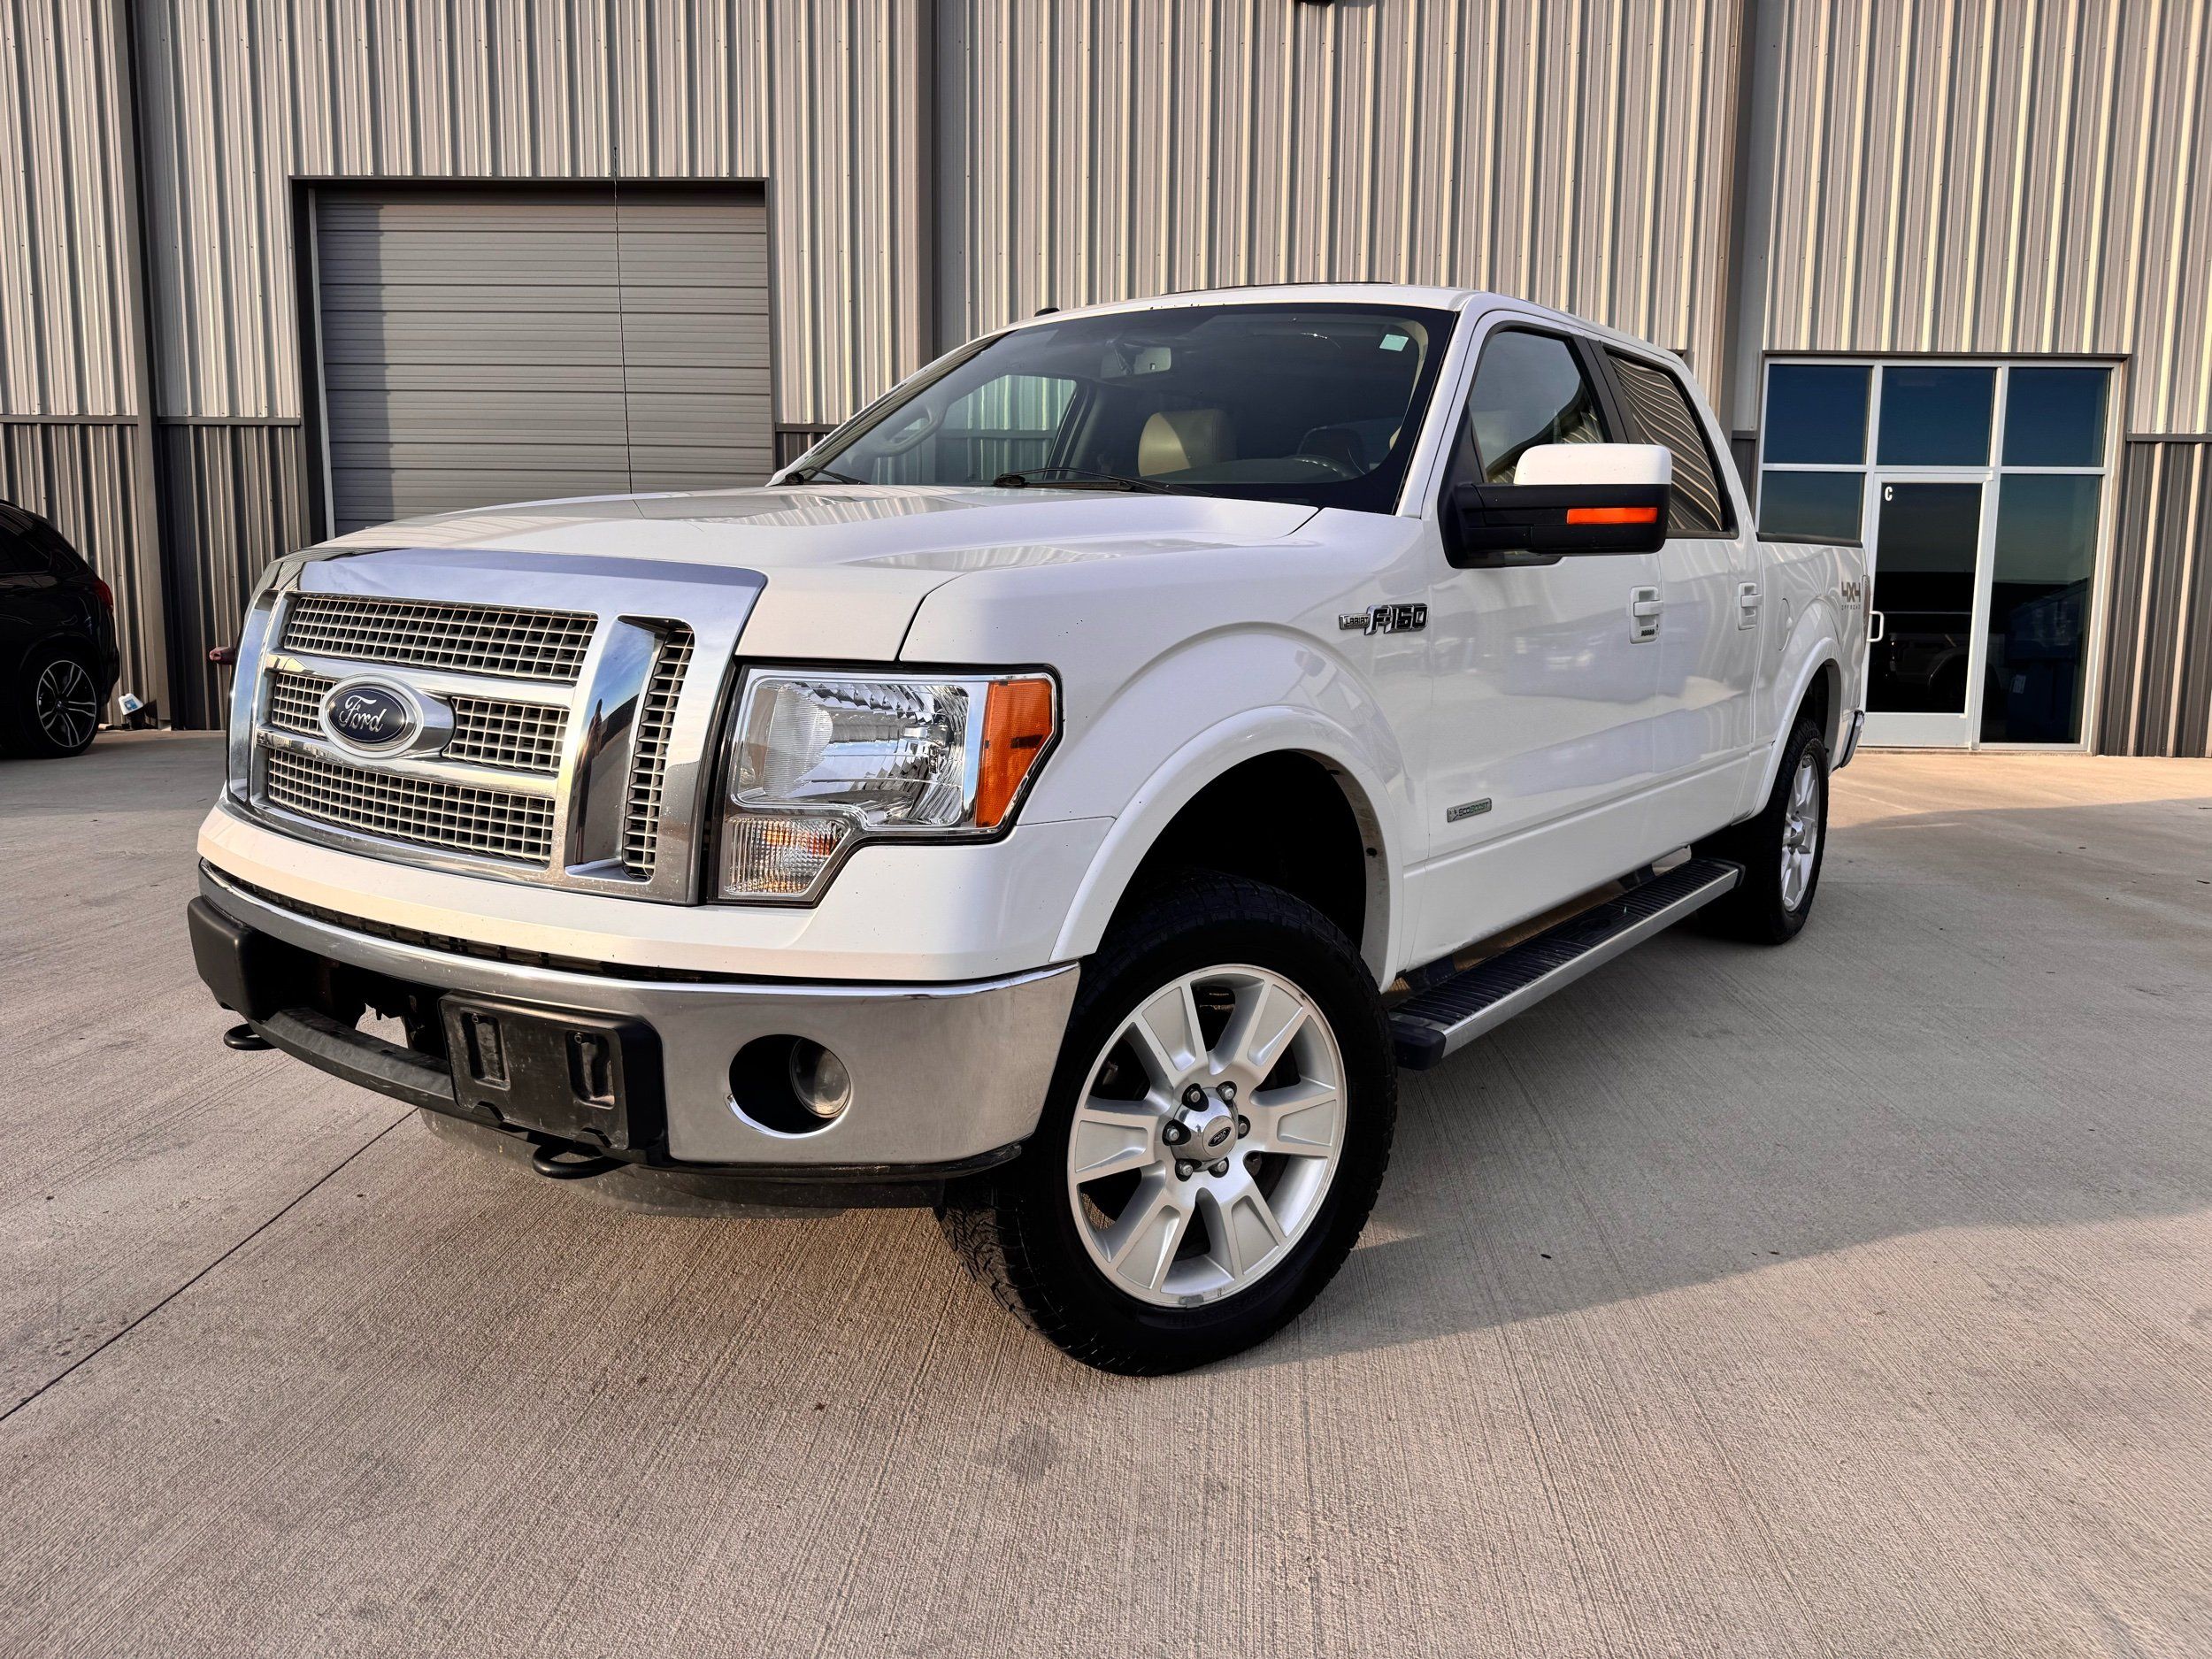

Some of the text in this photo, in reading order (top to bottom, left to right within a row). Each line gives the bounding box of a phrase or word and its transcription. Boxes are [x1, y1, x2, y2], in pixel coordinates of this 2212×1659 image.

[1885, 486, 1893, 502] C
[1346, 616, 1369, 625] LARIAT
[339, 695, 387, 733] Ford
